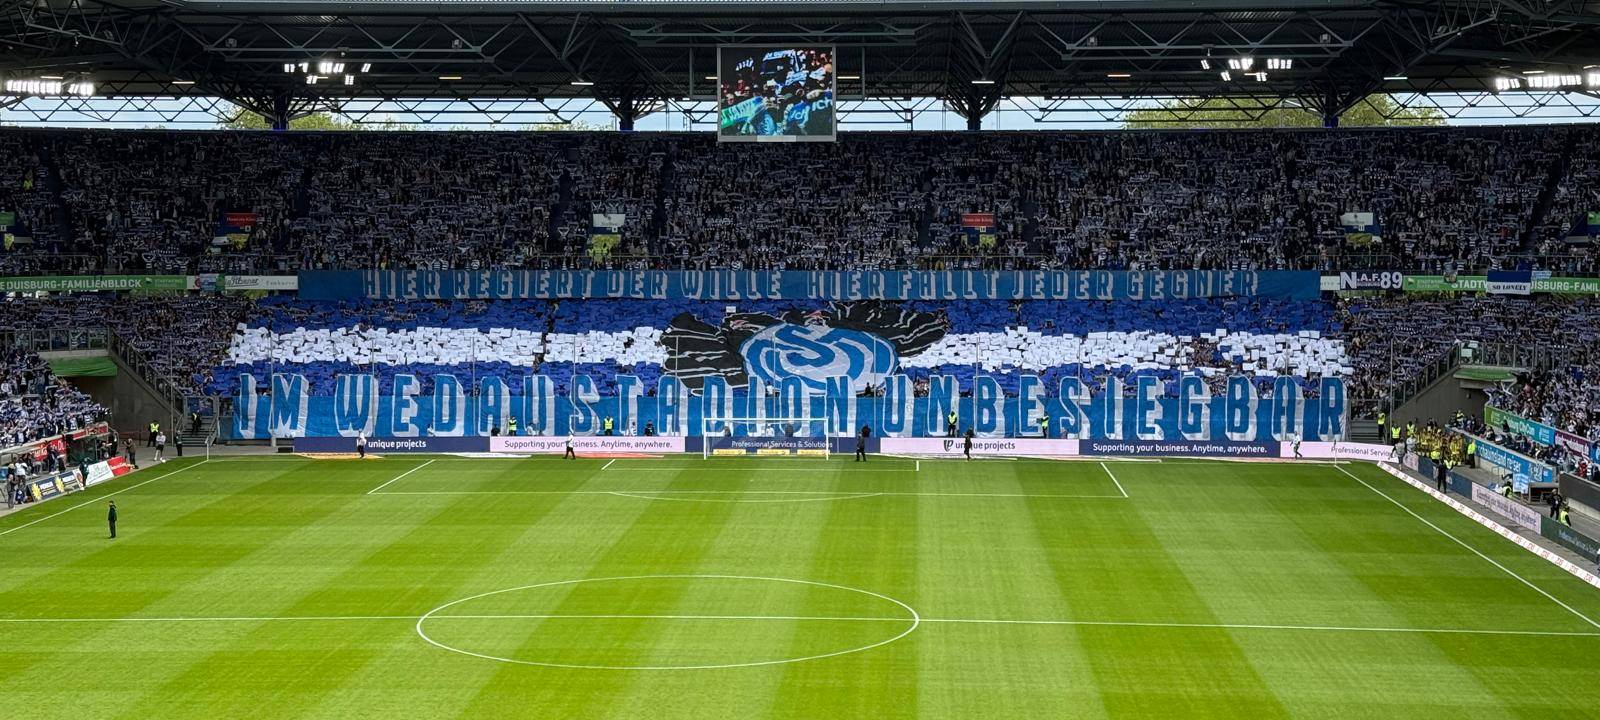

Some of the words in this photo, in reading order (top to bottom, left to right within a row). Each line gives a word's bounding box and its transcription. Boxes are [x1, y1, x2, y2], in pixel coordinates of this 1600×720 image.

[6, 279, 142, 290] DUISBURG-FAMILIENBLOCK
[362, 270, 440, 299] HIER
[452, 270, 595, 299] REGIERT
[607, 270, 668, 299] DER
[681, 270, 781, 299] WILLE
[807, 270, 885, 300] HIER
[1012, 270, 1114, 300] JEDER
[1126, 270, 1258, 300] GEGNER
[239, 373, 309, 438] IM
[334, 373, 857, 438] WEDAUSTADION
[882, 374, 1347, 441] UNBESIEGBAR
[368, 440, 396, 450] unique
[396, 440, 427, 450] projects
[505, 440, 545, 450] Supporting
[545, 442, 564, 450] your
[600, 440, 633, 450] Anytime,
[634, 440, 673, 450] anywhere.
[731, 440, 770, 449] Professional
[770, 440, 797, 448] Services
[798, 440, 803, 448] &
[984, 440, 1016, 451] projects
[1093, 443, 1135, 453] Supporting
[1136, 445, 1153, 453] your
[1155, 443, 1190, 452] business.
[1192, 444, 1225, 454] Anytime,
[1227, 445, 1267, 455] anywhere.
[1331, 446, 1369, 455] Professional
